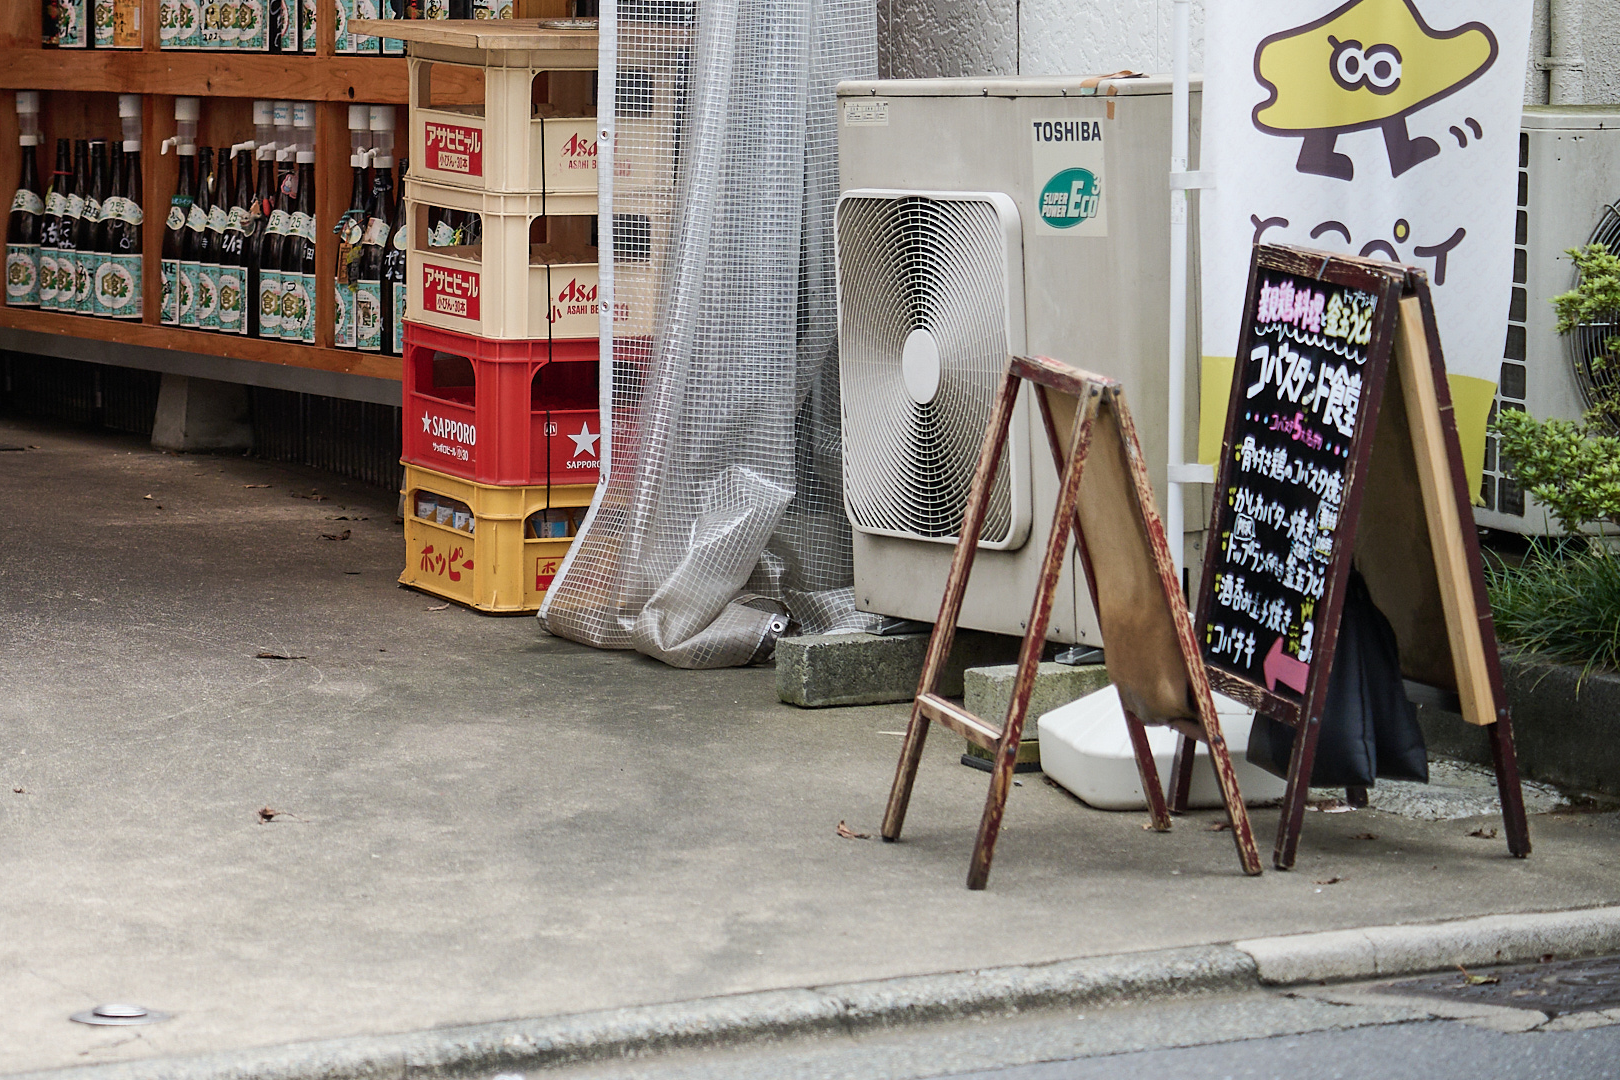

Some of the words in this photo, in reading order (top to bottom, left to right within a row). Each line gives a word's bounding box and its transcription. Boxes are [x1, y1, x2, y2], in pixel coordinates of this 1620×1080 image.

[426, 124, 481, 154] アサヒビール
[1033, 121, 1102, 142] TOSHIBA
[568, 159, 589, 170] ASAHI
[1043, 192, 1069, 205] SUPER
[271, 214, 281, 226] 25
[291, 216, 301, 228] 25
[1041, 205, 1068, 218] POWER
[424, 267, 479, 298] アサヒビール
[558, 278, 598, 303] Asa
[567, 304, 588, 315] ASAHI
[1246, 342, 1363, 439] コバスタンド食堂
[432, 415, 477, 447] SAPPORO
[432, 441, 457, 458] サッポロビール
[420, 540, 475, 582] ホッピー
[1211, 624, 1257, 669] コバチキ
